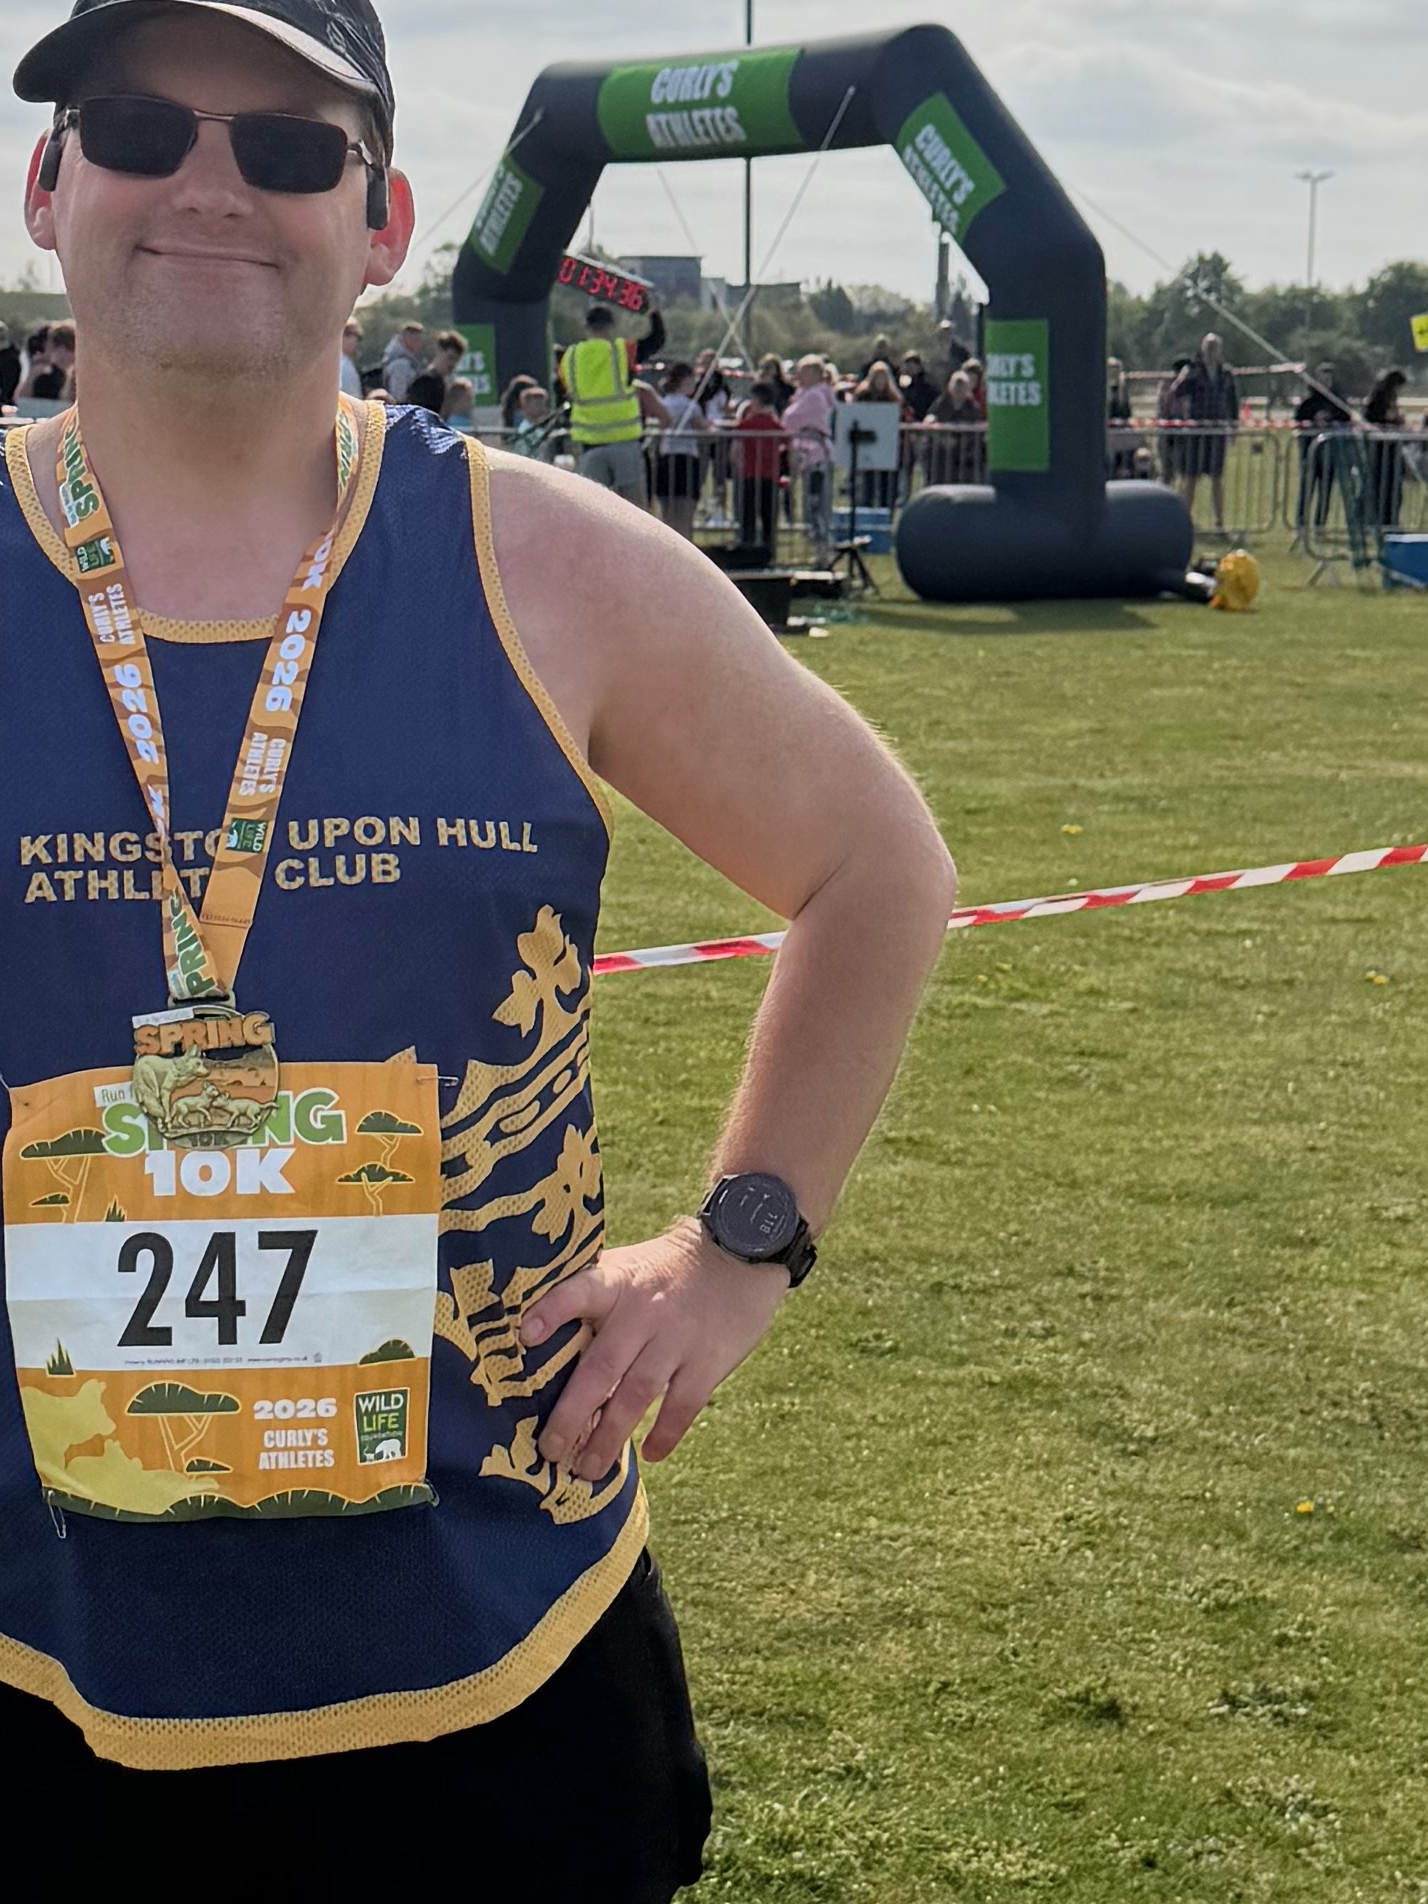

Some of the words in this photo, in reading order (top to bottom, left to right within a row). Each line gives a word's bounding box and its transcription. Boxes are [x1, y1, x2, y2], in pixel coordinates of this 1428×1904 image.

[651, 59, 740, 103] CURLY'S
[646, 106, 747, 148] ATHLETES
[915, 123, 975, 205] CURLY'S
[89, 592, 115, 644] CURLY'S
[106, 583, 136, 645] ATHLETES
[265, 609, 311, 712] 2026
[113, 664, 160, 765] 2026
[239, 732, 268, 797] ATHLETES
[259, 738, 286, 794] CURLY'S
[253, 822, 267, 852] WILD
[288, 816, 420, 851] UPON
[437, 817, 538, 854] HULL
[275, 853, 401, 890] CLUB
[134, 1011, 275, 1055] SPRING
[102, 1087, 125, 1102] Run
[144, 1149, 296, 1196] 10K
[117, 1230, 318, 1346] 247
[253, 1398, 337, 1420] 2026
[358, 1393, 404, 1414] WILD
[363, 1413, 399, 1432] LIFE
[259, 1449, 335, 1470] ATHLETES
[264, 1428, 328, 1448] CURLY'S
